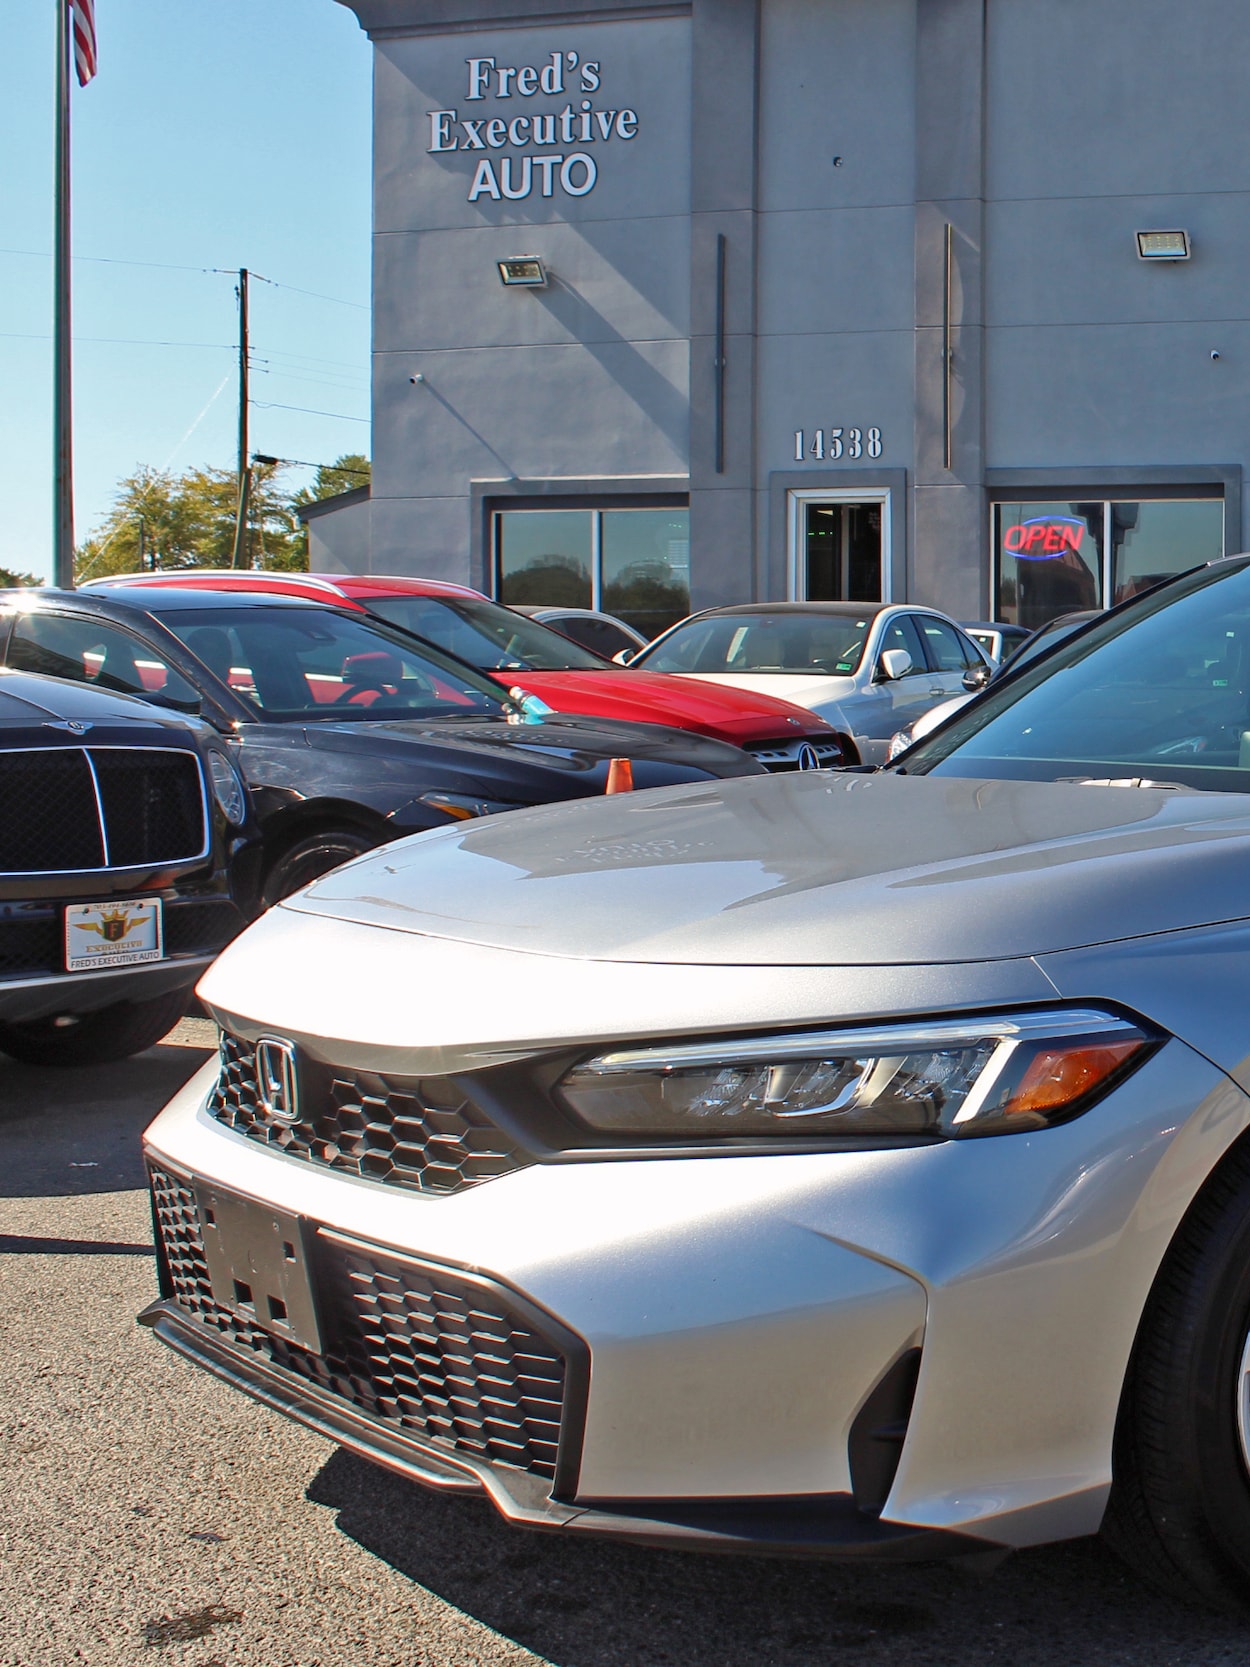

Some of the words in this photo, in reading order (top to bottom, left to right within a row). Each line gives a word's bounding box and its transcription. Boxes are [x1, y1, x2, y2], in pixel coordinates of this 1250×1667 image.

[464, 51, 600, 100] Fred's
[426, 100, 638, 153] Executive
[467, 152, 598, 202] AUTO
[794, 427, 882, 461] 14538
[1003, 525, 1085, 551] OPEN
[70, 959, 97, 969] FRED'S
[98, 953, 138, 965] EXECUTIVE
[139, 951, 160, 960] AUTO
